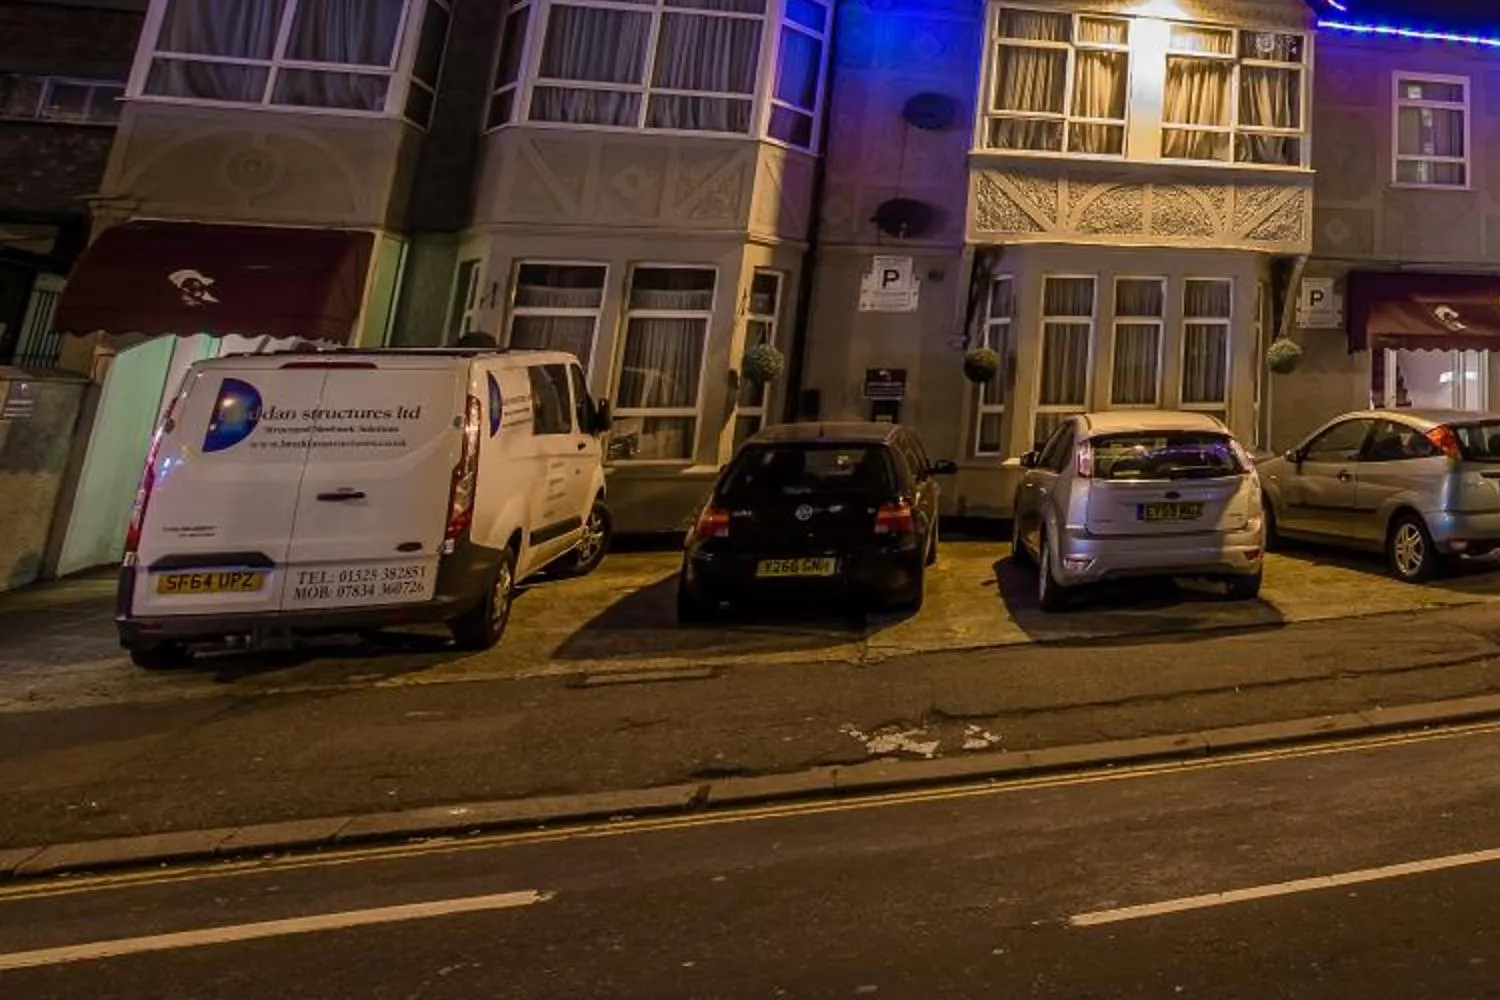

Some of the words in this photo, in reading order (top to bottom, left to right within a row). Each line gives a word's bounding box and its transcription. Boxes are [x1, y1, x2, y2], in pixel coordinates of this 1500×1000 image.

[882, 269, 899, 287] P
[1310, 290, 1324, 306] P
[302, 406, 392, 420] structures
[396, 405, 423, 420] ltd
[166, 574, 212, 590] SF64
[218, 573, 254, 589] UPZ
[296, 571, 335, 585] TEL:
[293, 585, 335, 601] MOB:
